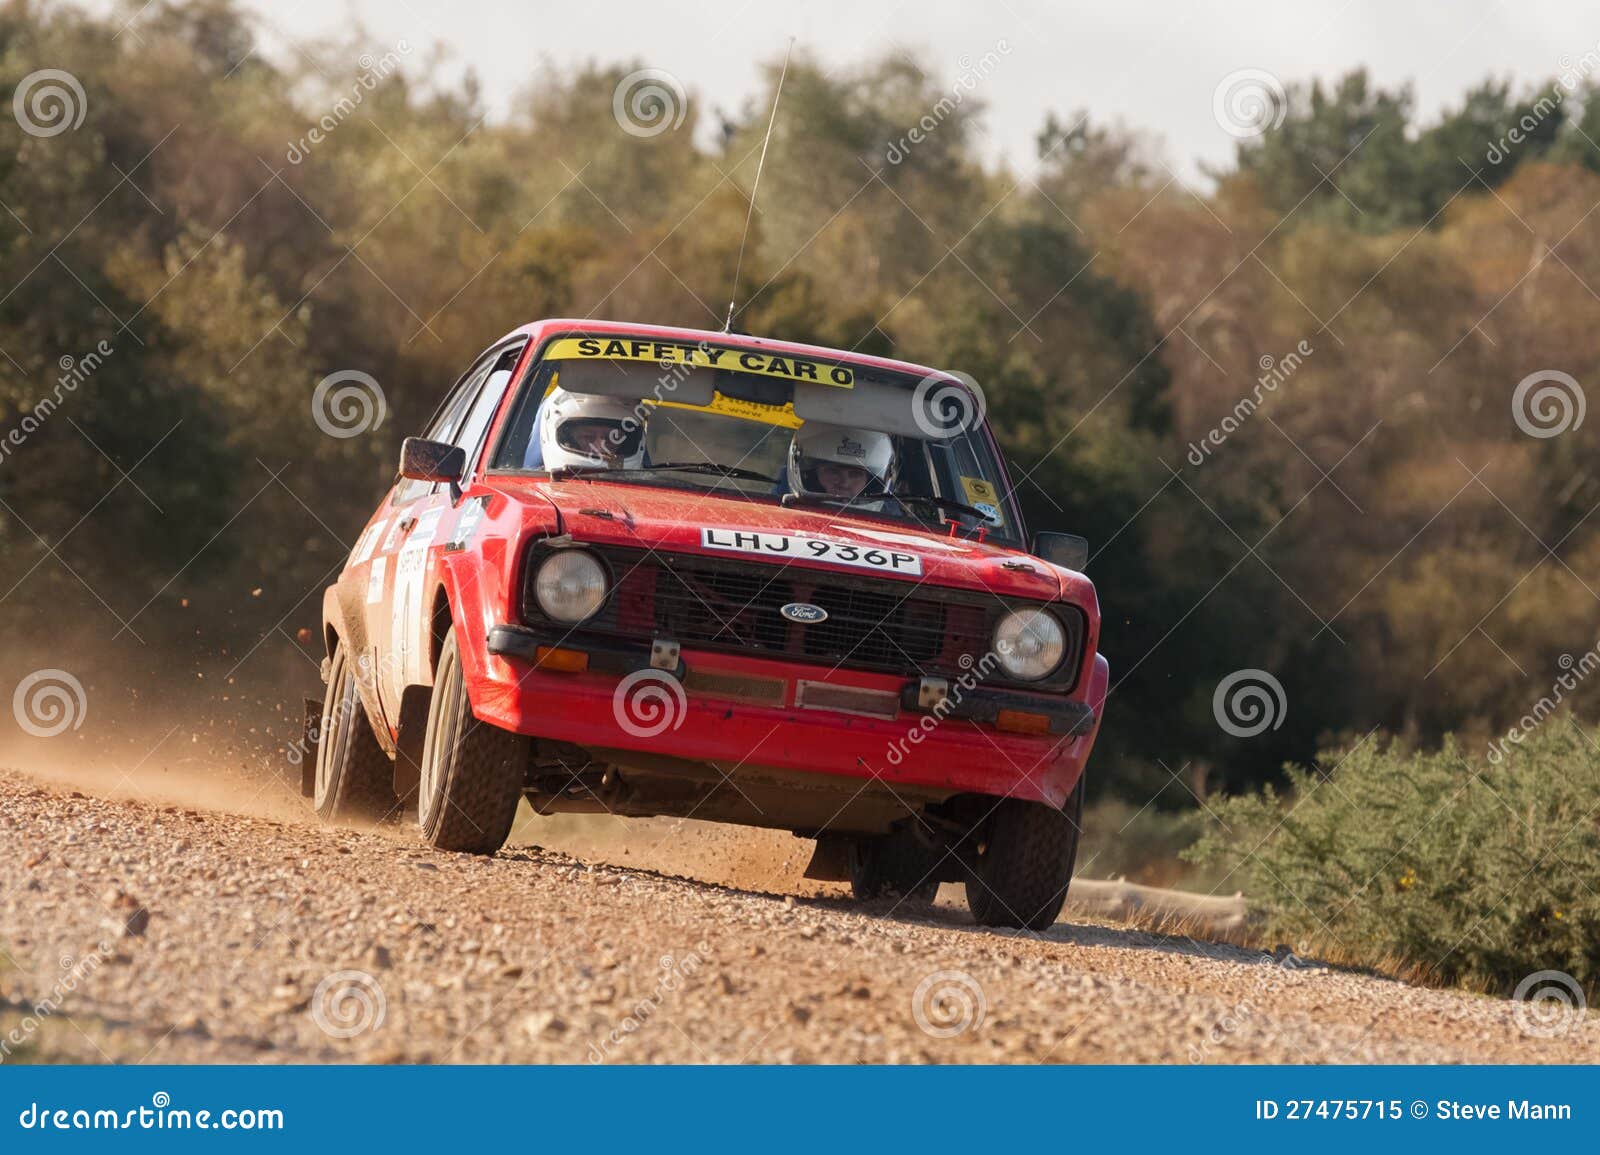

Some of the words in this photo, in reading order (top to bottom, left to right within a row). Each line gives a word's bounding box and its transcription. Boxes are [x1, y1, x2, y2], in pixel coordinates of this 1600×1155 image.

[578, 339, 726, 365] SAFETY
[739, 353, 818, 380] CAR
[706, 529, 790, 552] LHJ
[806, 540, 915, 568] 936P
